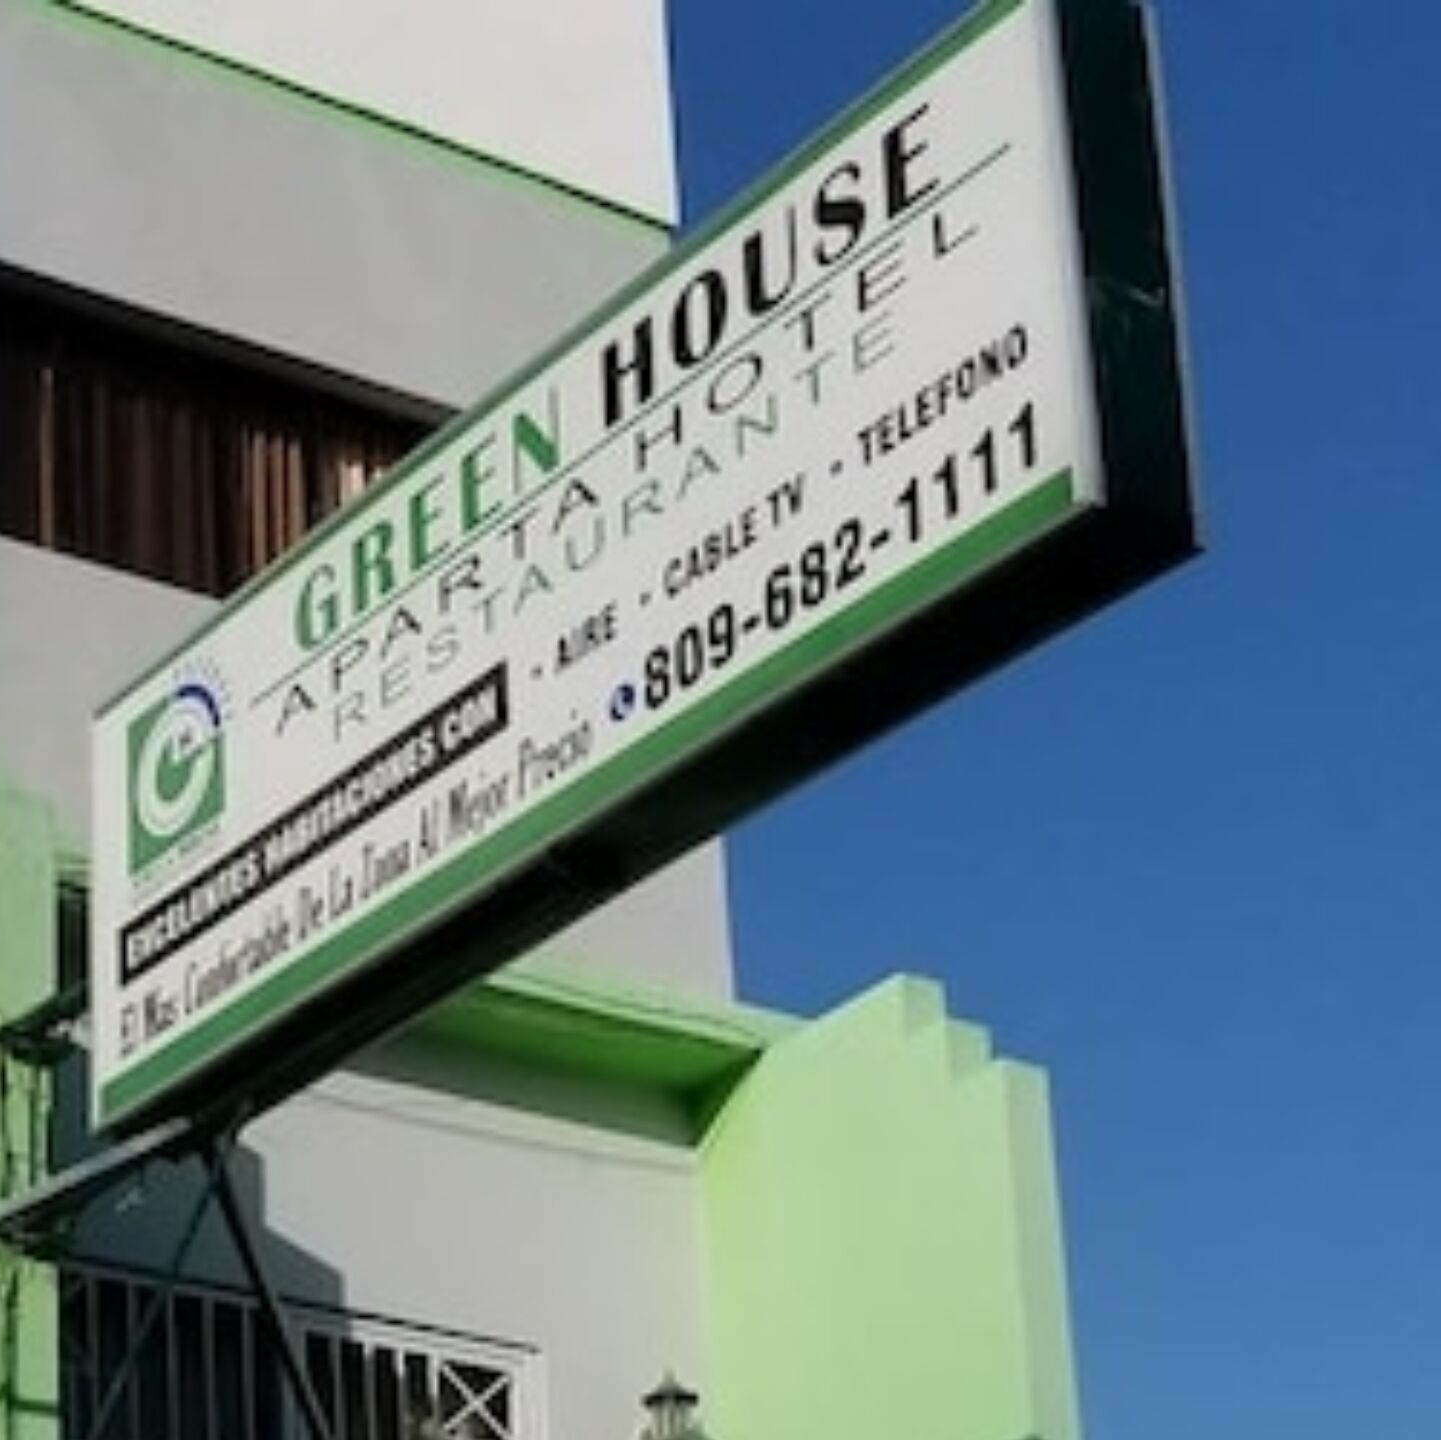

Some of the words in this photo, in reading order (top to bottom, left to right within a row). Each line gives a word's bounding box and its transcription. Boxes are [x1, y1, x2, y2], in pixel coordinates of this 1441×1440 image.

[275, 477, 600, 738] APARTA
[634, 212, 979, 472] HOTEL
[294, 382, 560, 652] GREEN
[601, 102, 941, 429] HOUSE
[334, 309, 896, 742] RESTAURANTE
[556, 602, 616, 673] AIRE
[663, 507, 756, 597] CABLE
[766, 473, 806, 527] TV
[857, 324, 1028, 466] TELEFONO
[643, 400, 1038, 711] 809-682-1111
[444, 683, 497, 750] CON
